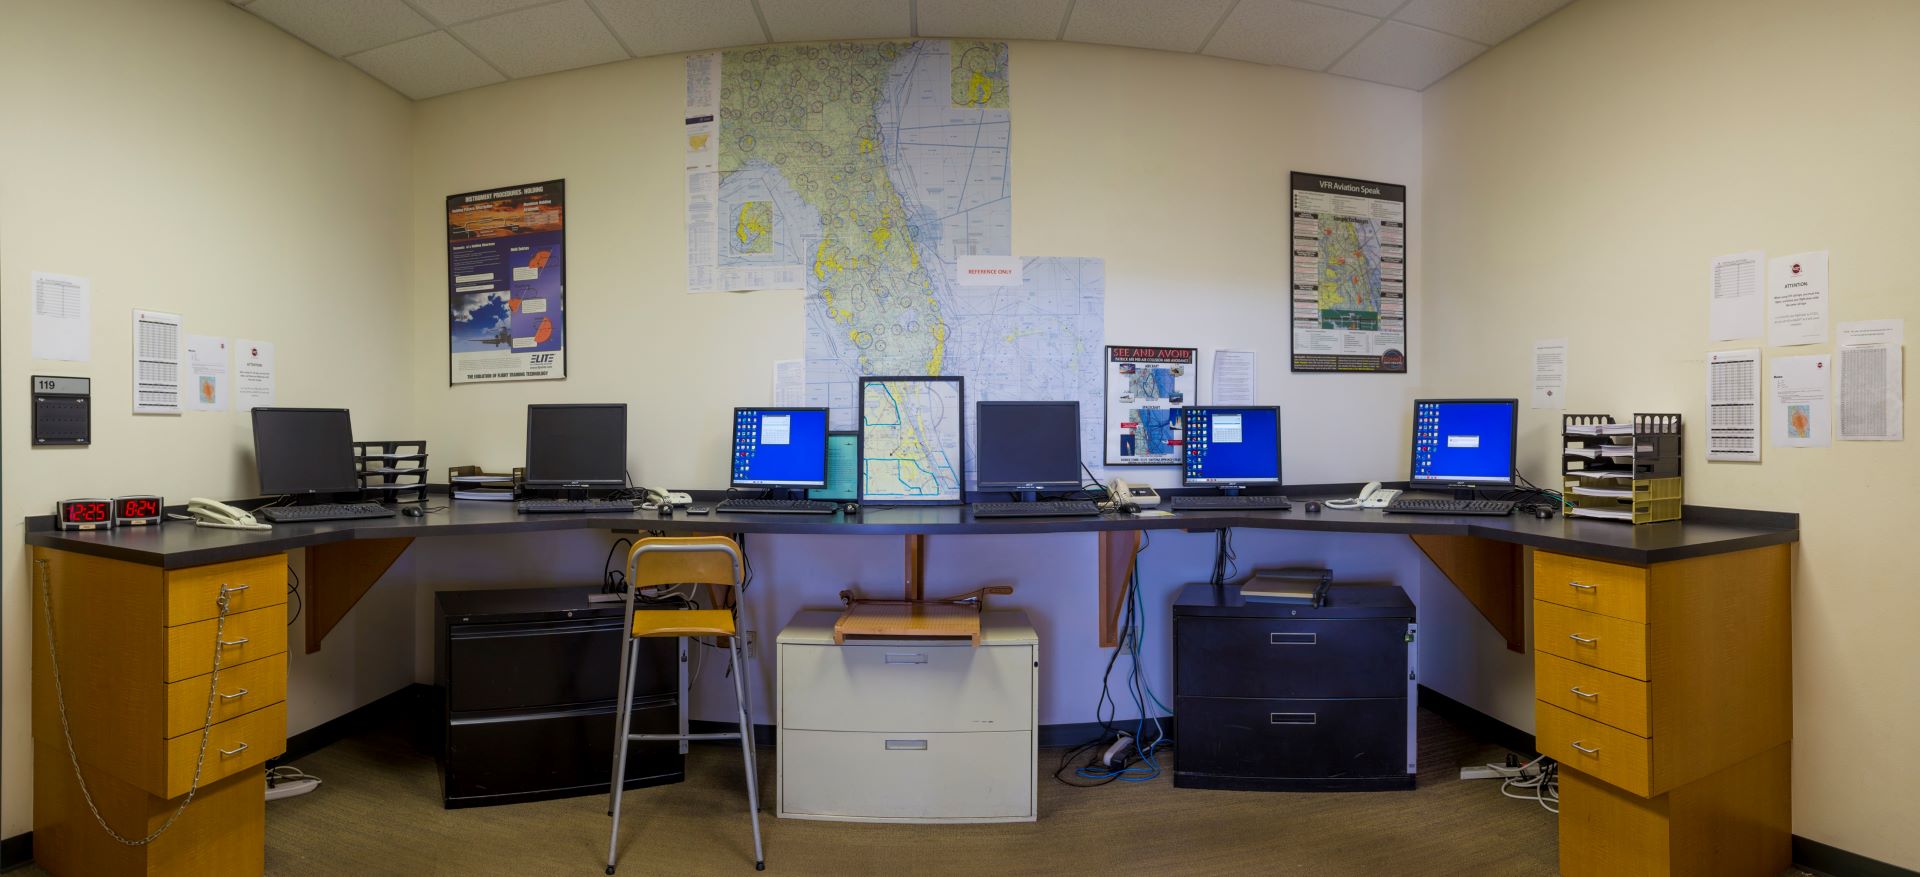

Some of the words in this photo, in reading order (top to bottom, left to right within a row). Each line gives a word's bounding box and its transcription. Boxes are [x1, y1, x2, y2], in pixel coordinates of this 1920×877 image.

[1319, 180, 1333, 190] VFR
[1334, 182, 1360, 193] Aviation
[1360, 186, 1381, 195] Speak
[465, 193, 493, 203] INSTRUMENT
[524, 186, 544, 195] HOLDING
[530, 353, 555, 363] ELITE
[1113, 348, 1130, 357] SEE
[1133, 348, 1155, 358] AND
[38, 379, 55, 390] 119
[66, 503, 106, 521] 12:25
[125, 500, 156, 517] 8:24
